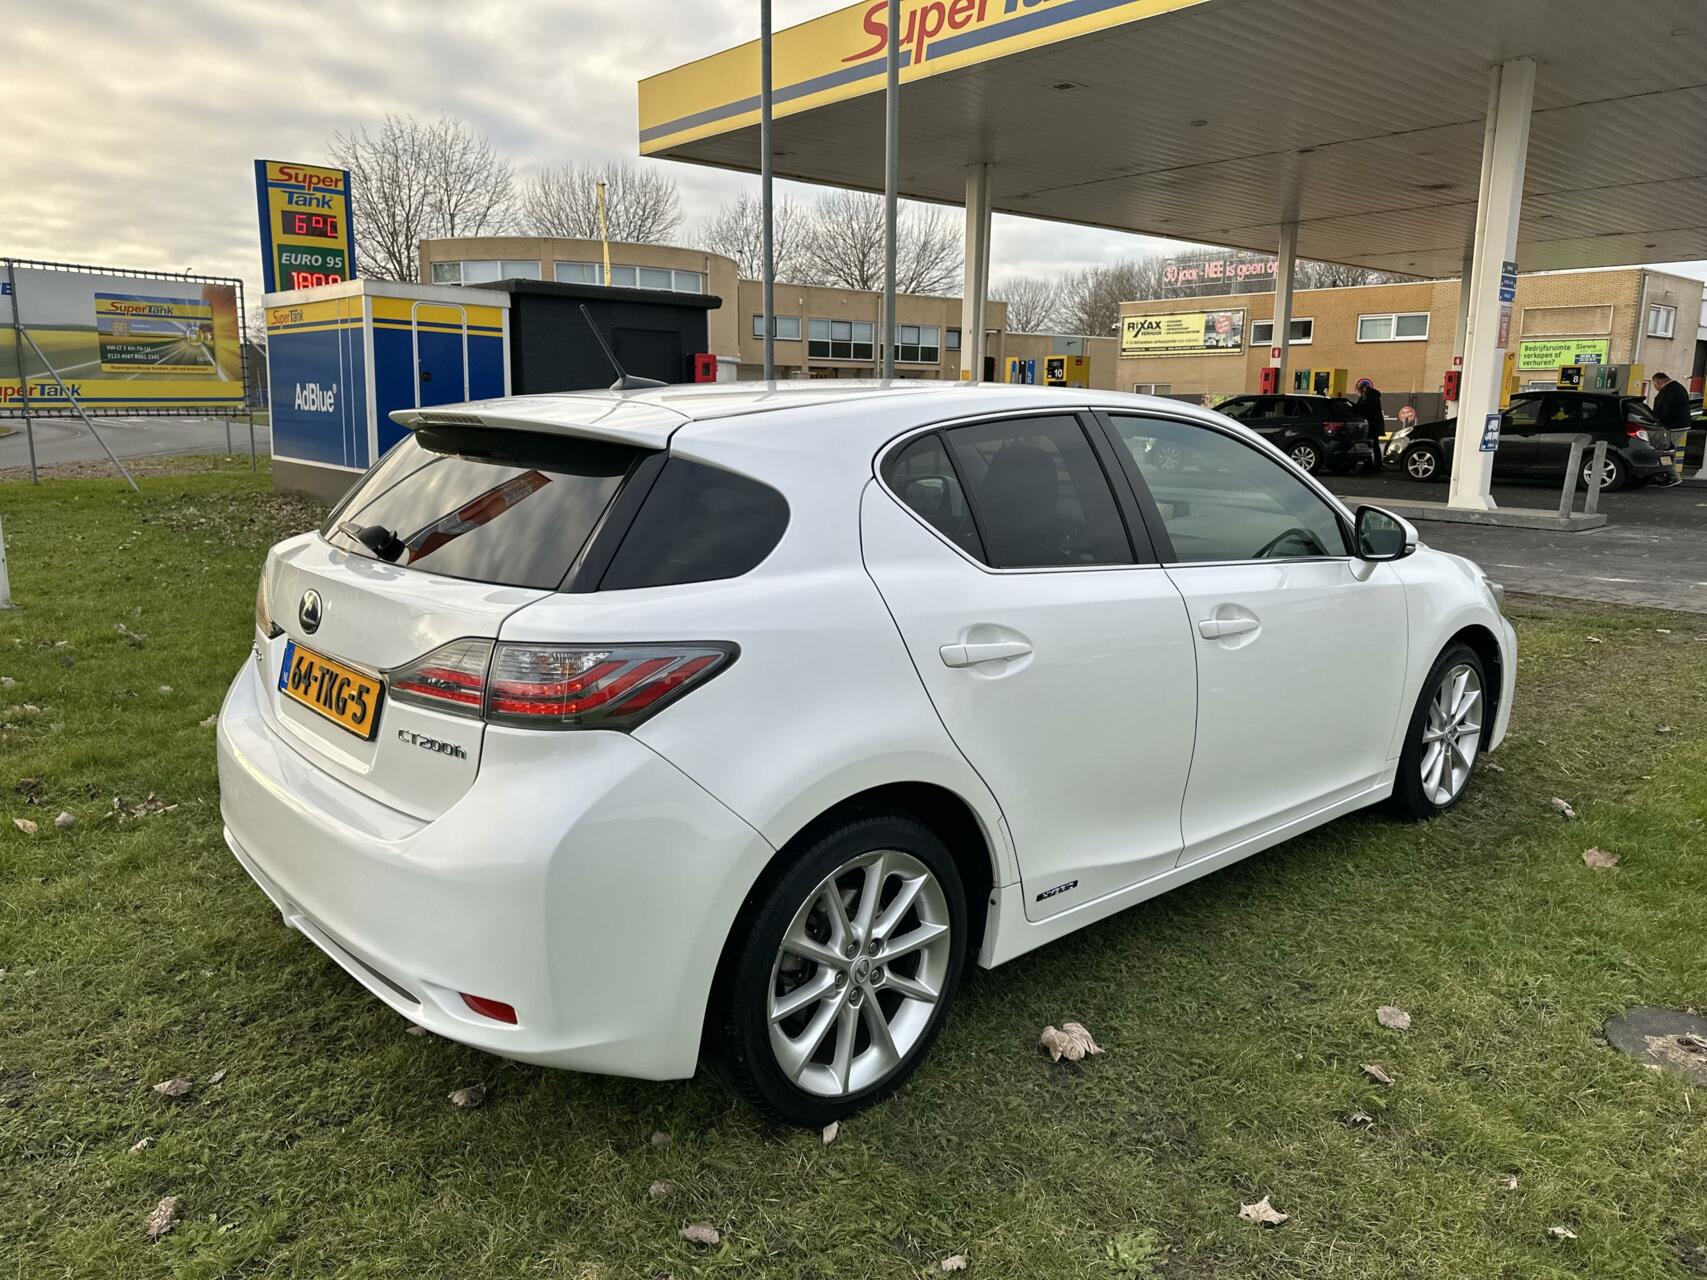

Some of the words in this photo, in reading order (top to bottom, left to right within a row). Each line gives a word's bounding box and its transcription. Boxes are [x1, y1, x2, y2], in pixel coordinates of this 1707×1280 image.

[267, 165, 342, 191] Super
[281, 190, 333, 209] Tank
[281, 252, 322, 266] EURO
[326, 256, 342, 268] 95
[1204, 261, 1224, 278] NEE
[1226, 261, 1236, 277] is
[1237, 262, 1265, 281] geen
[105, 301, 174, 316] SuperTank
[1054, 369, 1063, 377] 10
[291, 656, 371, 725] 64-TKG-5
[398, 729, 466, 760] CT200h
